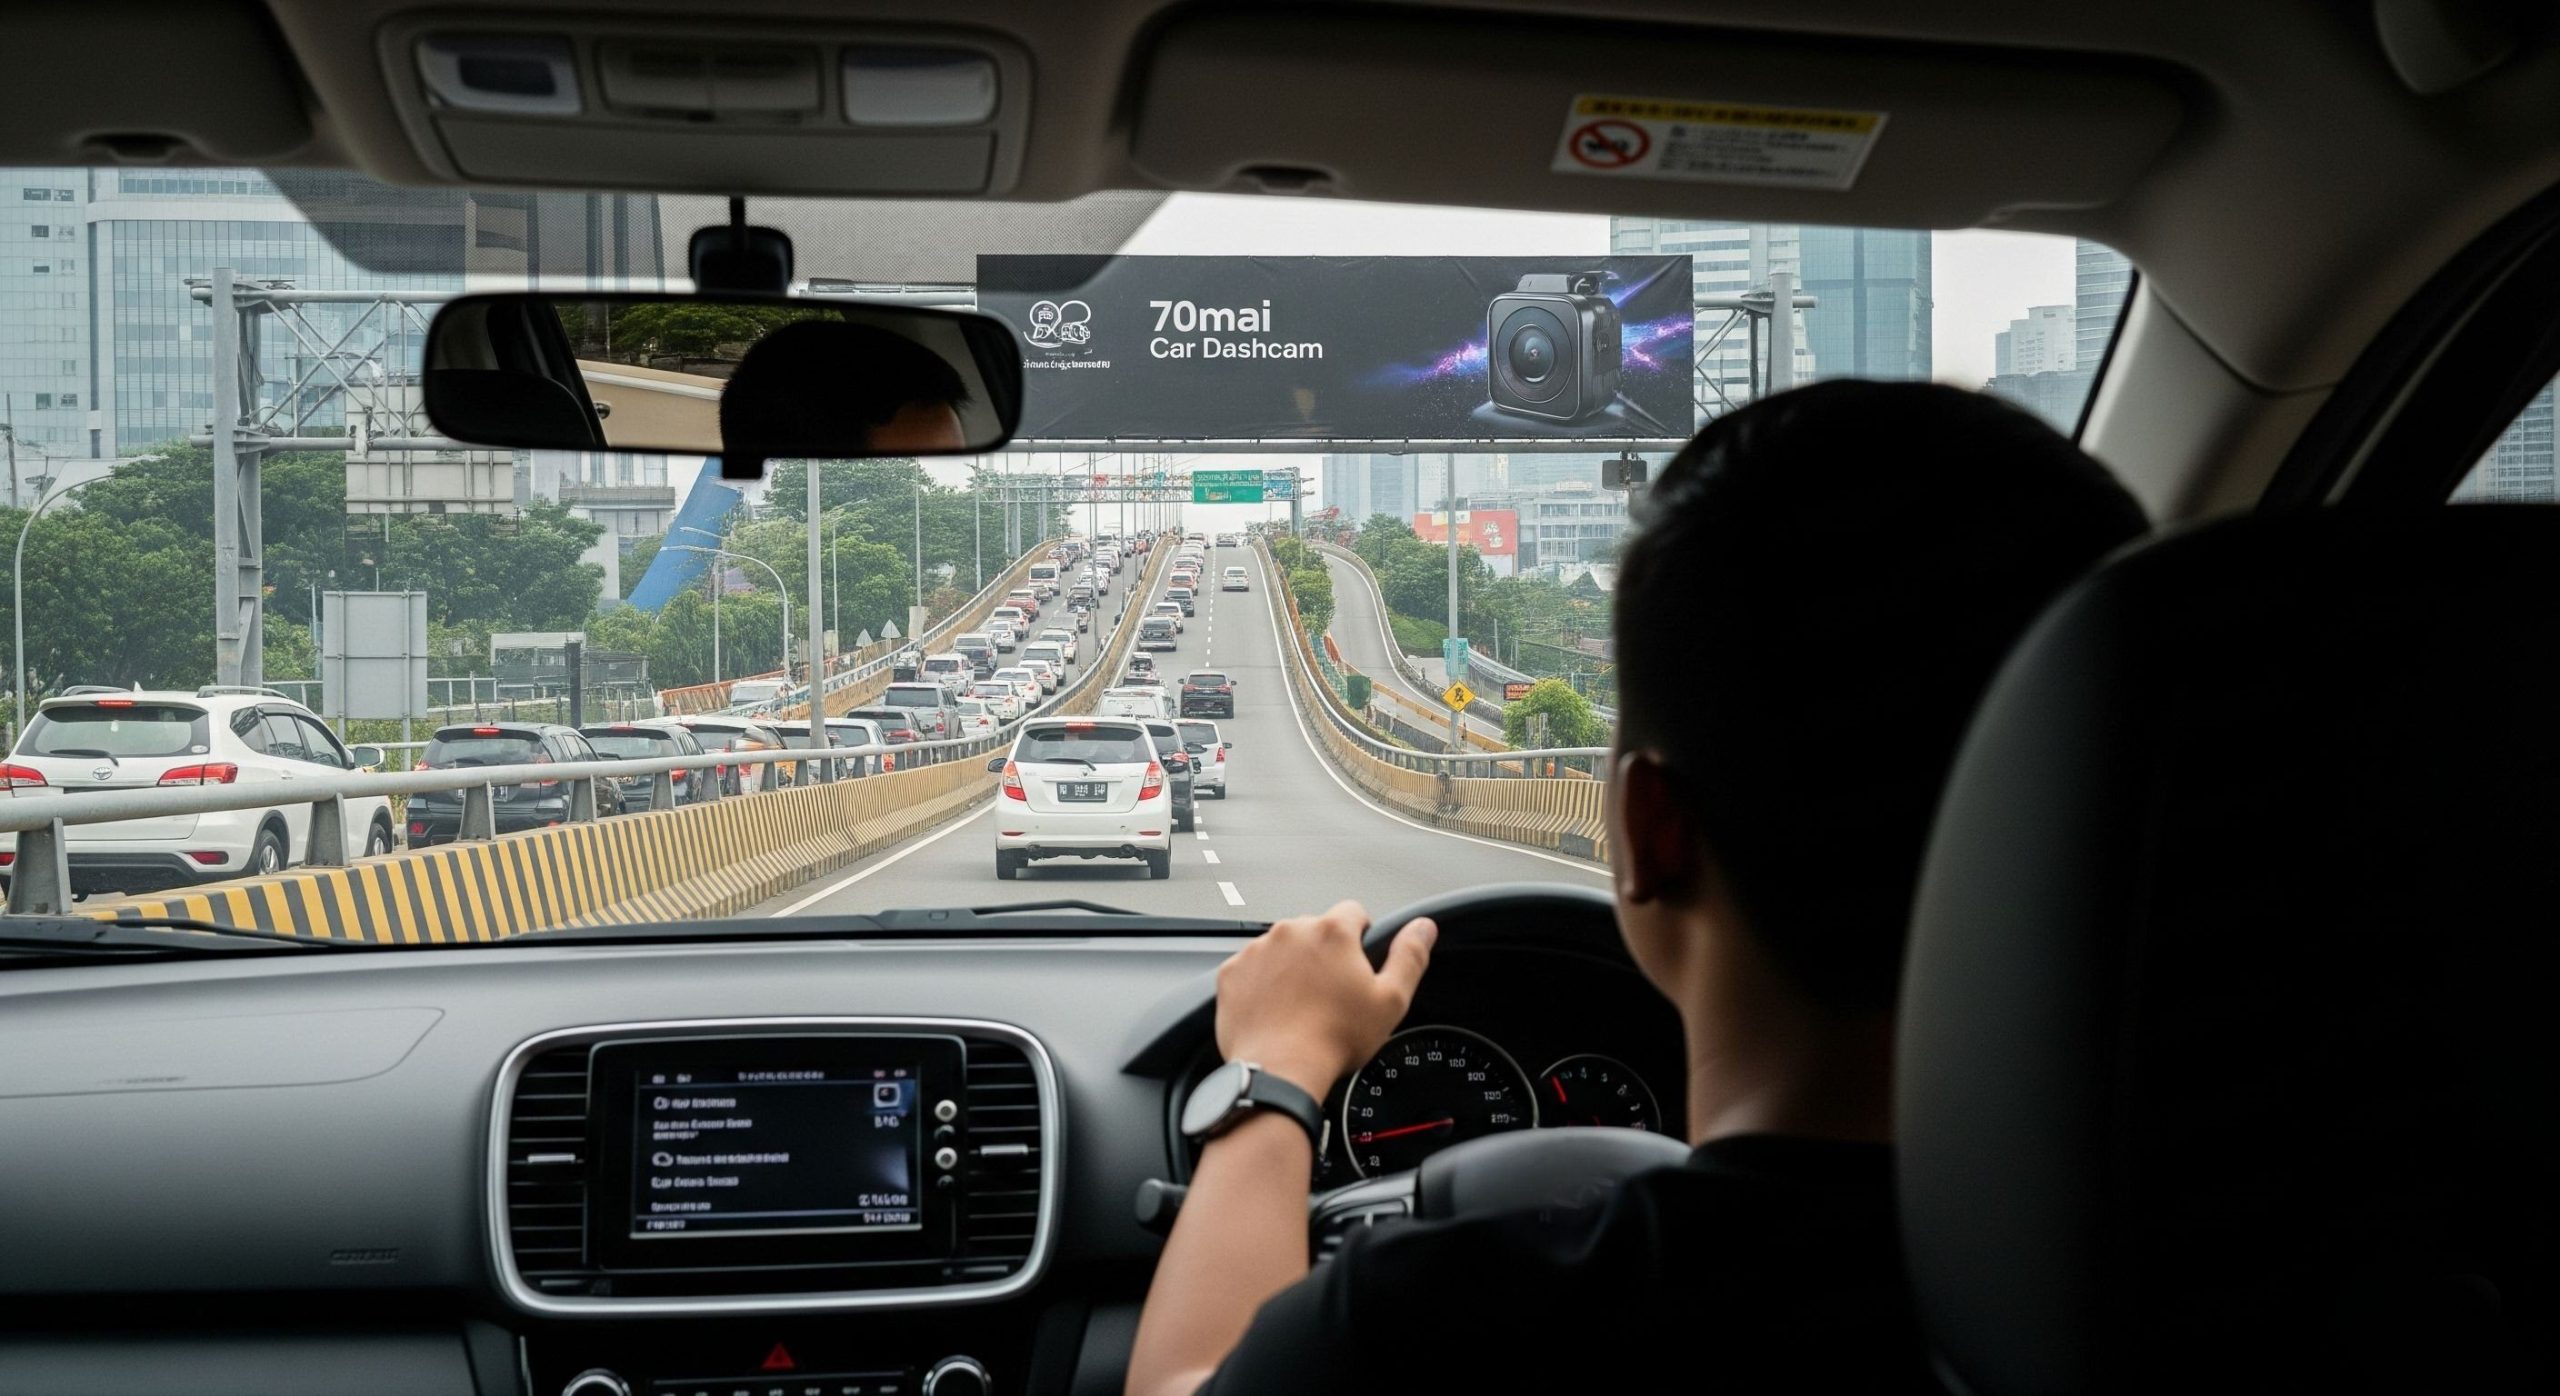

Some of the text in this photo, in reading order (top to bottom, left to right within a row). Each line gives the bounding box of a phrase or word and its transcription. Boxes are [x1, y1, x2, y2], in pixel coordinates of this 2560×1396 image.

[1150, 300, 1271, 332] 70mai
[1150, 337, 1323, 359] Car Dashcam
